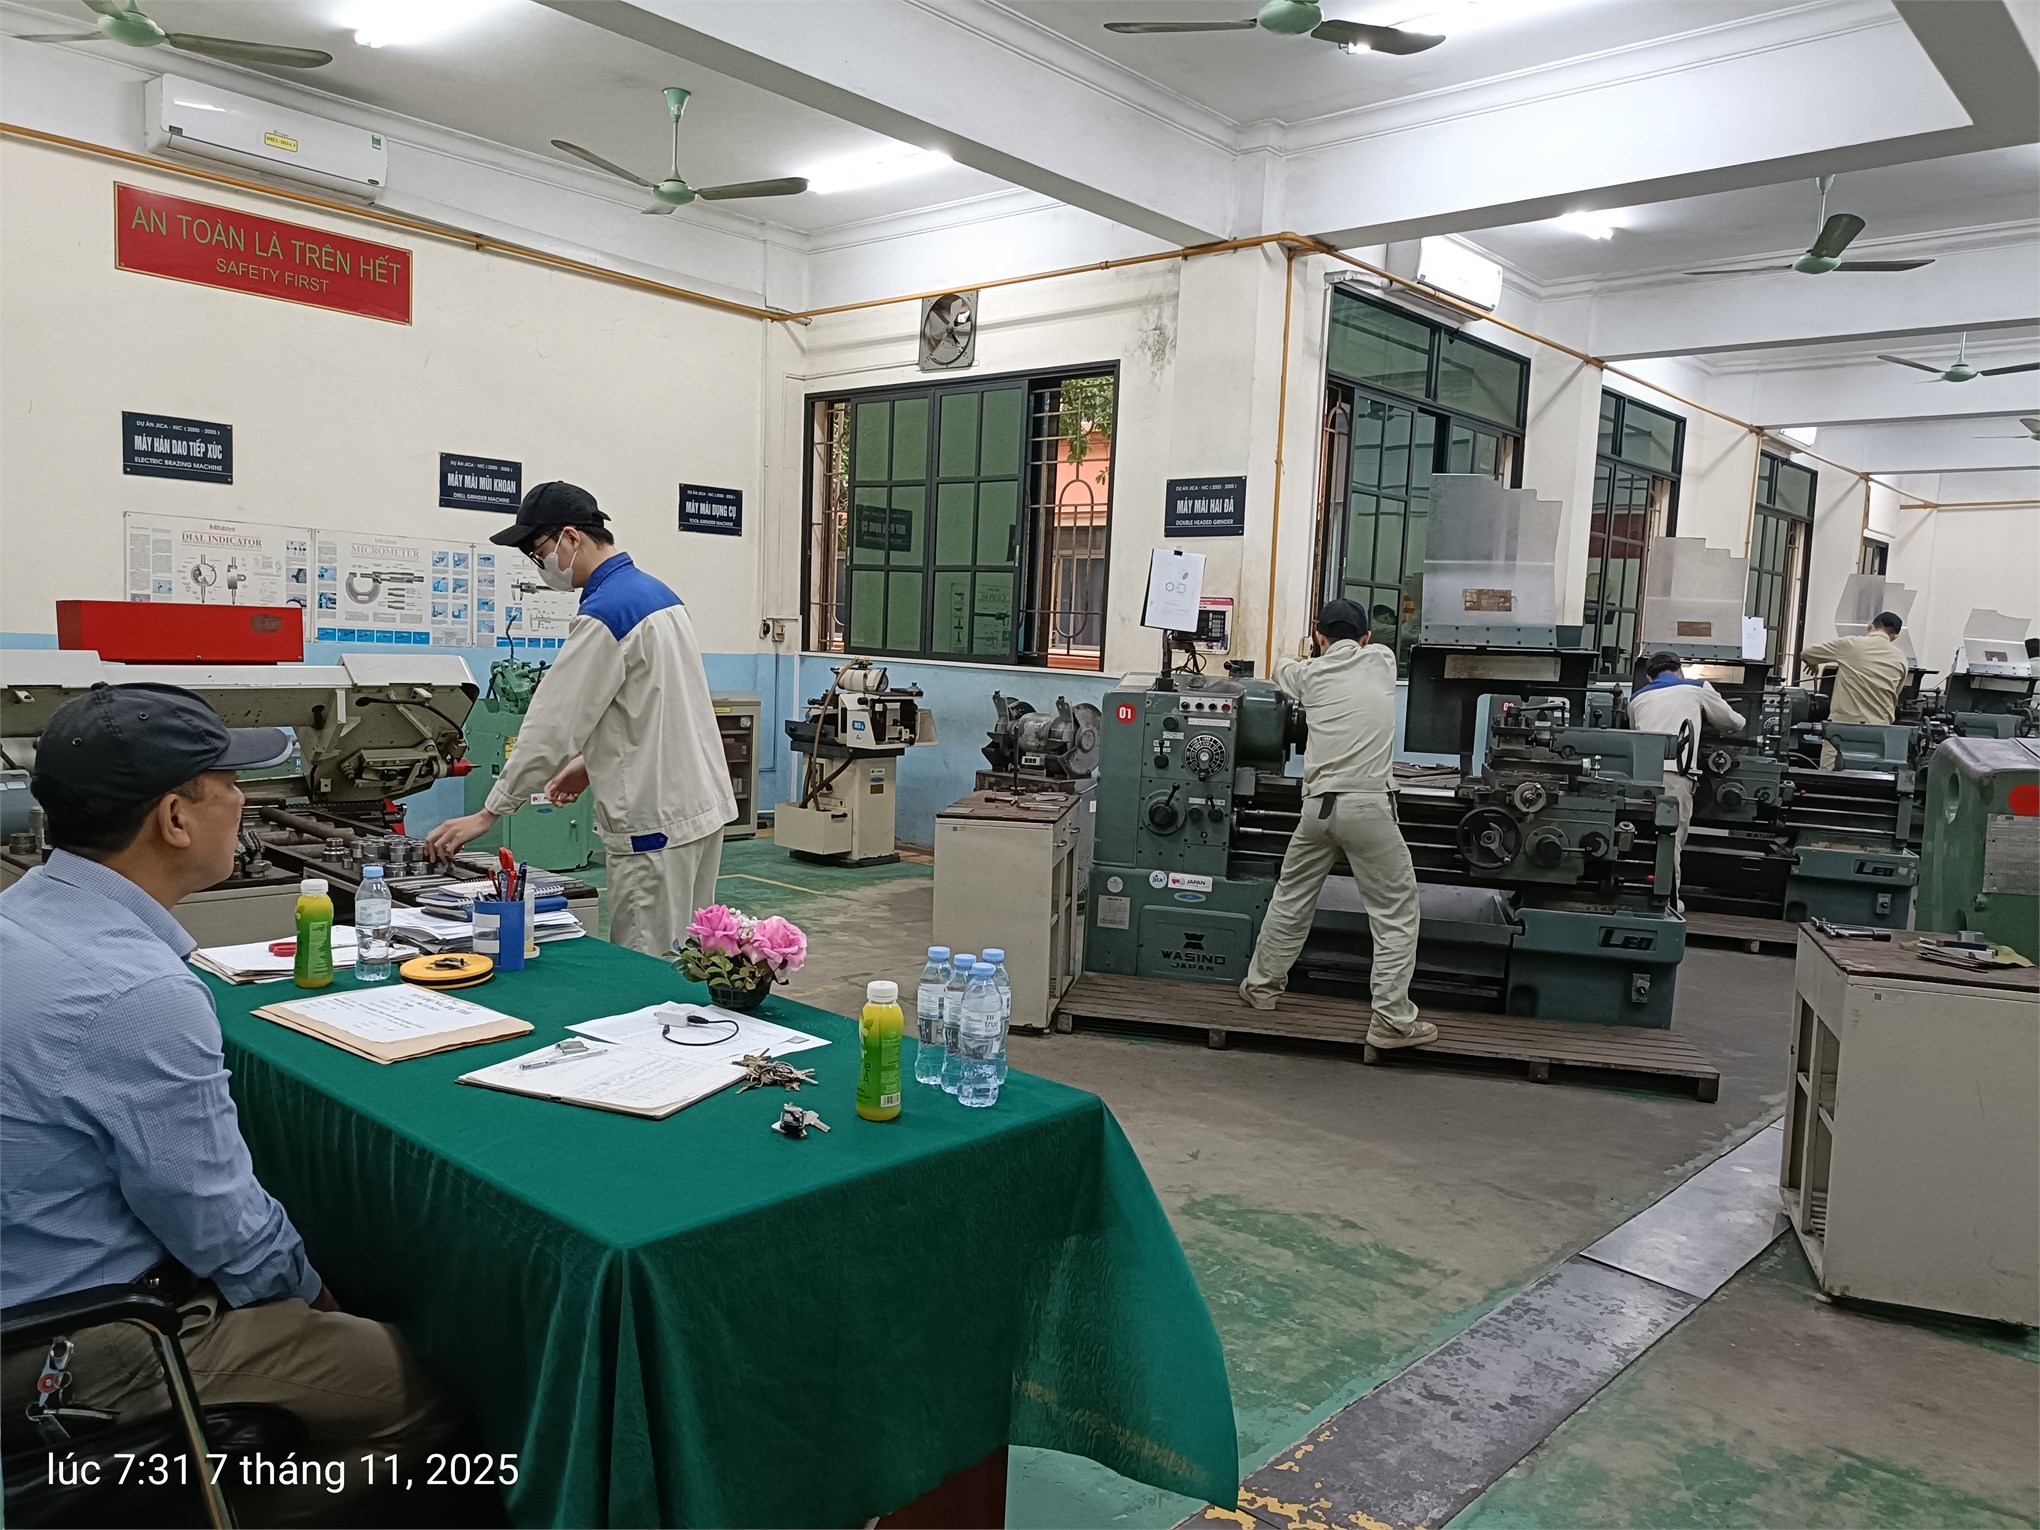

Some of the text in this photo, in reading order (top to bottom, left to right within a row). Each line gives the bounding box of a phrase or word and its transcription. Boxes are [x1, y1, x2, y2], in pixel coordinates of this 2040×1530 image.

[131, 205, 401, 286] AN TOÀN LÀ TRÊN HẾT
[216, 258, 330, 293] SAFETY FIRST
[134, 433, 223, 459] MÁY HÀN DAO TIẾP XÚC
[135, 456, 223, 471] ELECTRIC BRAZING MACHINE
[447, 471, 463, 487] MÁY
[493, 478, 516, 494] KHOAN
[686, 499, 699, 514] MÁY
[712, 504, 727, 518] DỤNG
[1176, 497, 1193, 514] MÁY
[1209, 499, 1223, 513] HAI
[1223, 495, 1234, 513] ĐÁ
[182, 533, 206, 541] DIAL
[209, 535, 262, 546] INDICATOR
[352, 545, 419, 558] MICROMETER
[1119, 707, 1132, 719] 01
[1161, 949, 1226, 965] WASINO
[1171, 962, 1214, 971] JAPAN
